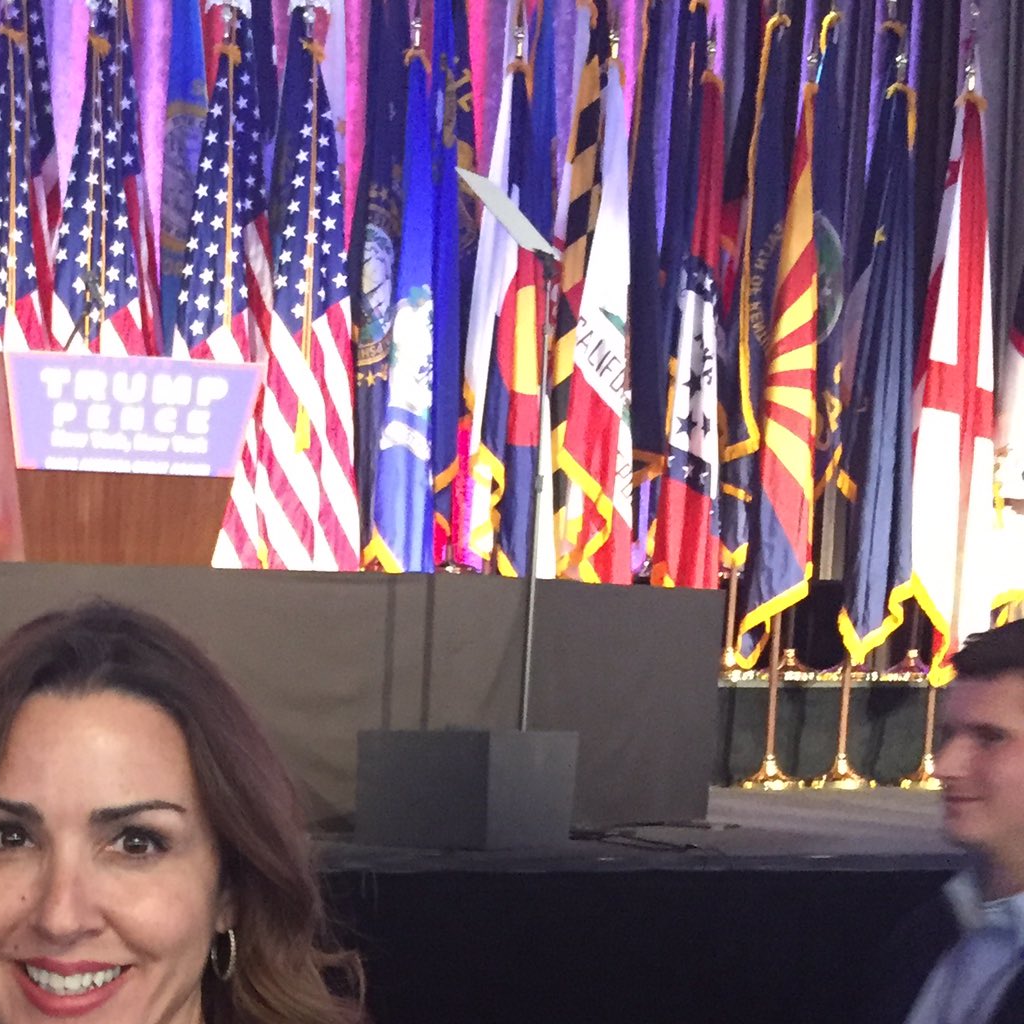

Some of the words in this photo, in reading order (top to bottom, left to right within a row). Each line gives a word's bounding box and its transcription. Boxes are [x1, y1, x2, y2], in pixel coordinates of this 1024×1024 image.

[576, 315, 627, 395] CALIFO
[39, 367, 229, 407] TRUMP
[52, 401, 211, 435] PENCE
